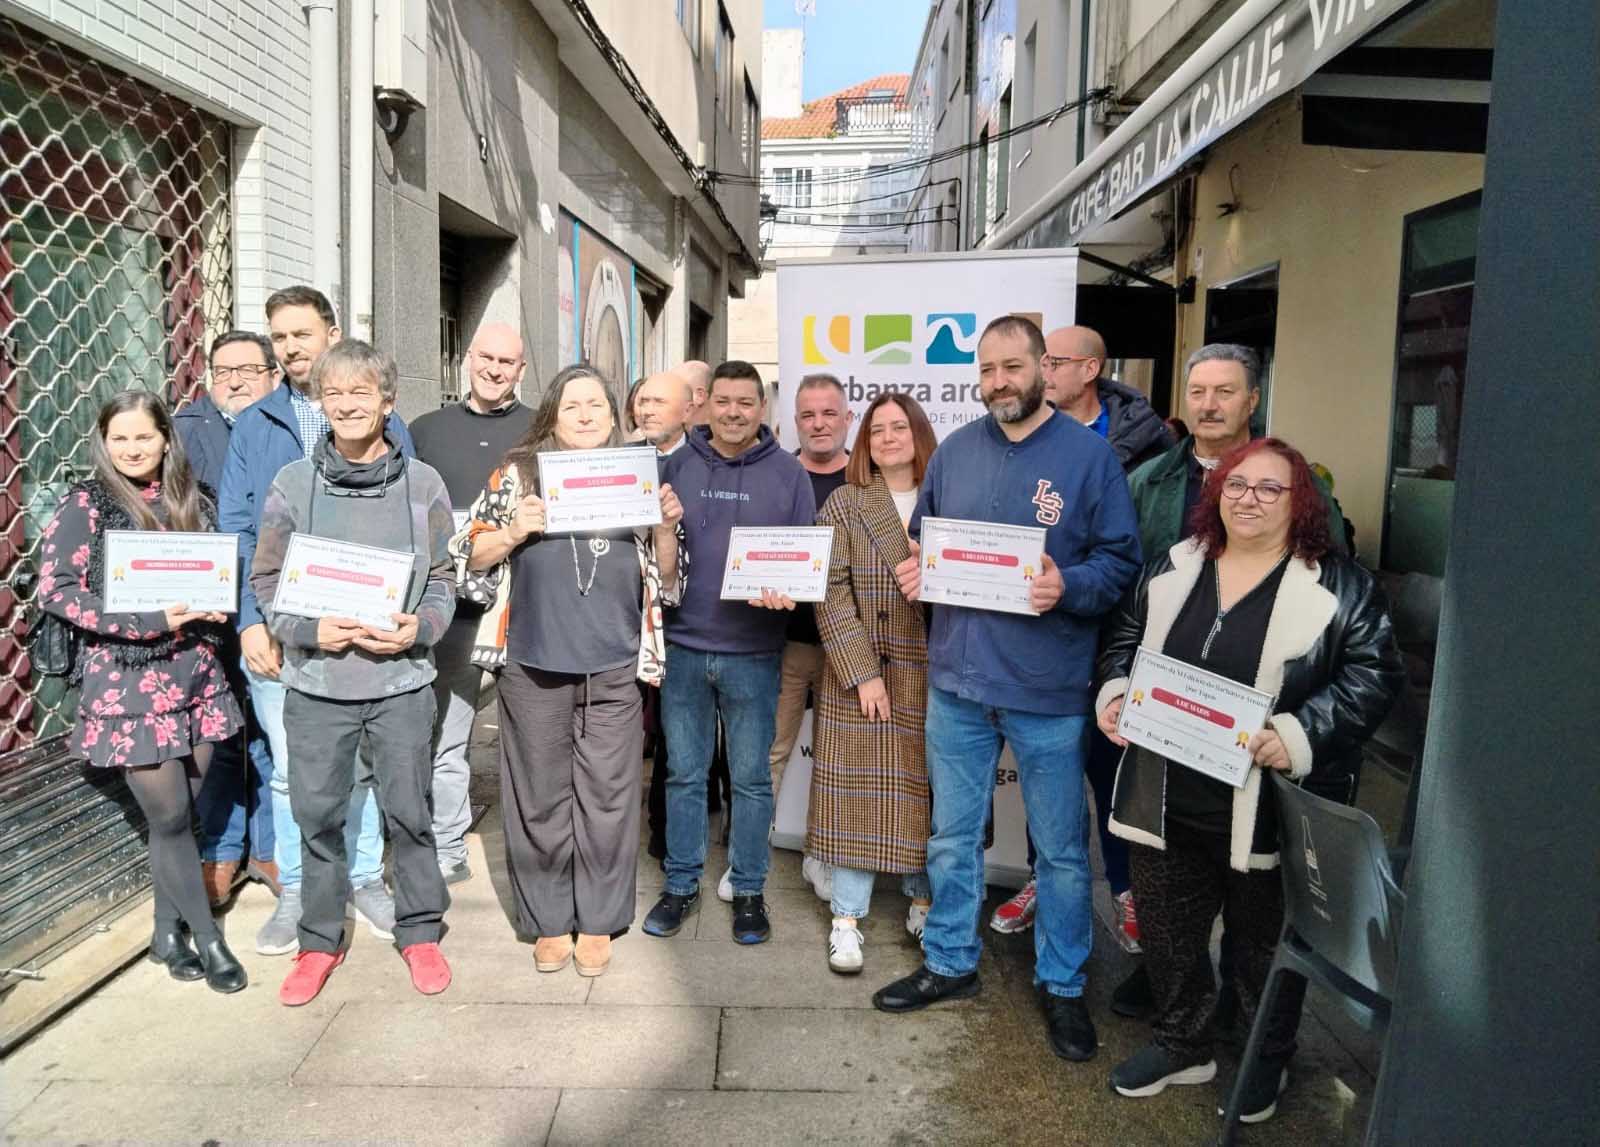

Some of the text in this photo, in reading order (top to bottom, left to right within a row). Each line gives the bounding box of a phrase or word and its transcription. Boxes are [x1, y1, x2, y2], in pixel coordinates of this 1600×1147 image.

[1109, 142, 1145, 207] BAR
[1153, 108, 1182, 180] LA
[1190, 14, 1287, 145] CALLE
[1308, 0, 1376, 51] VI
